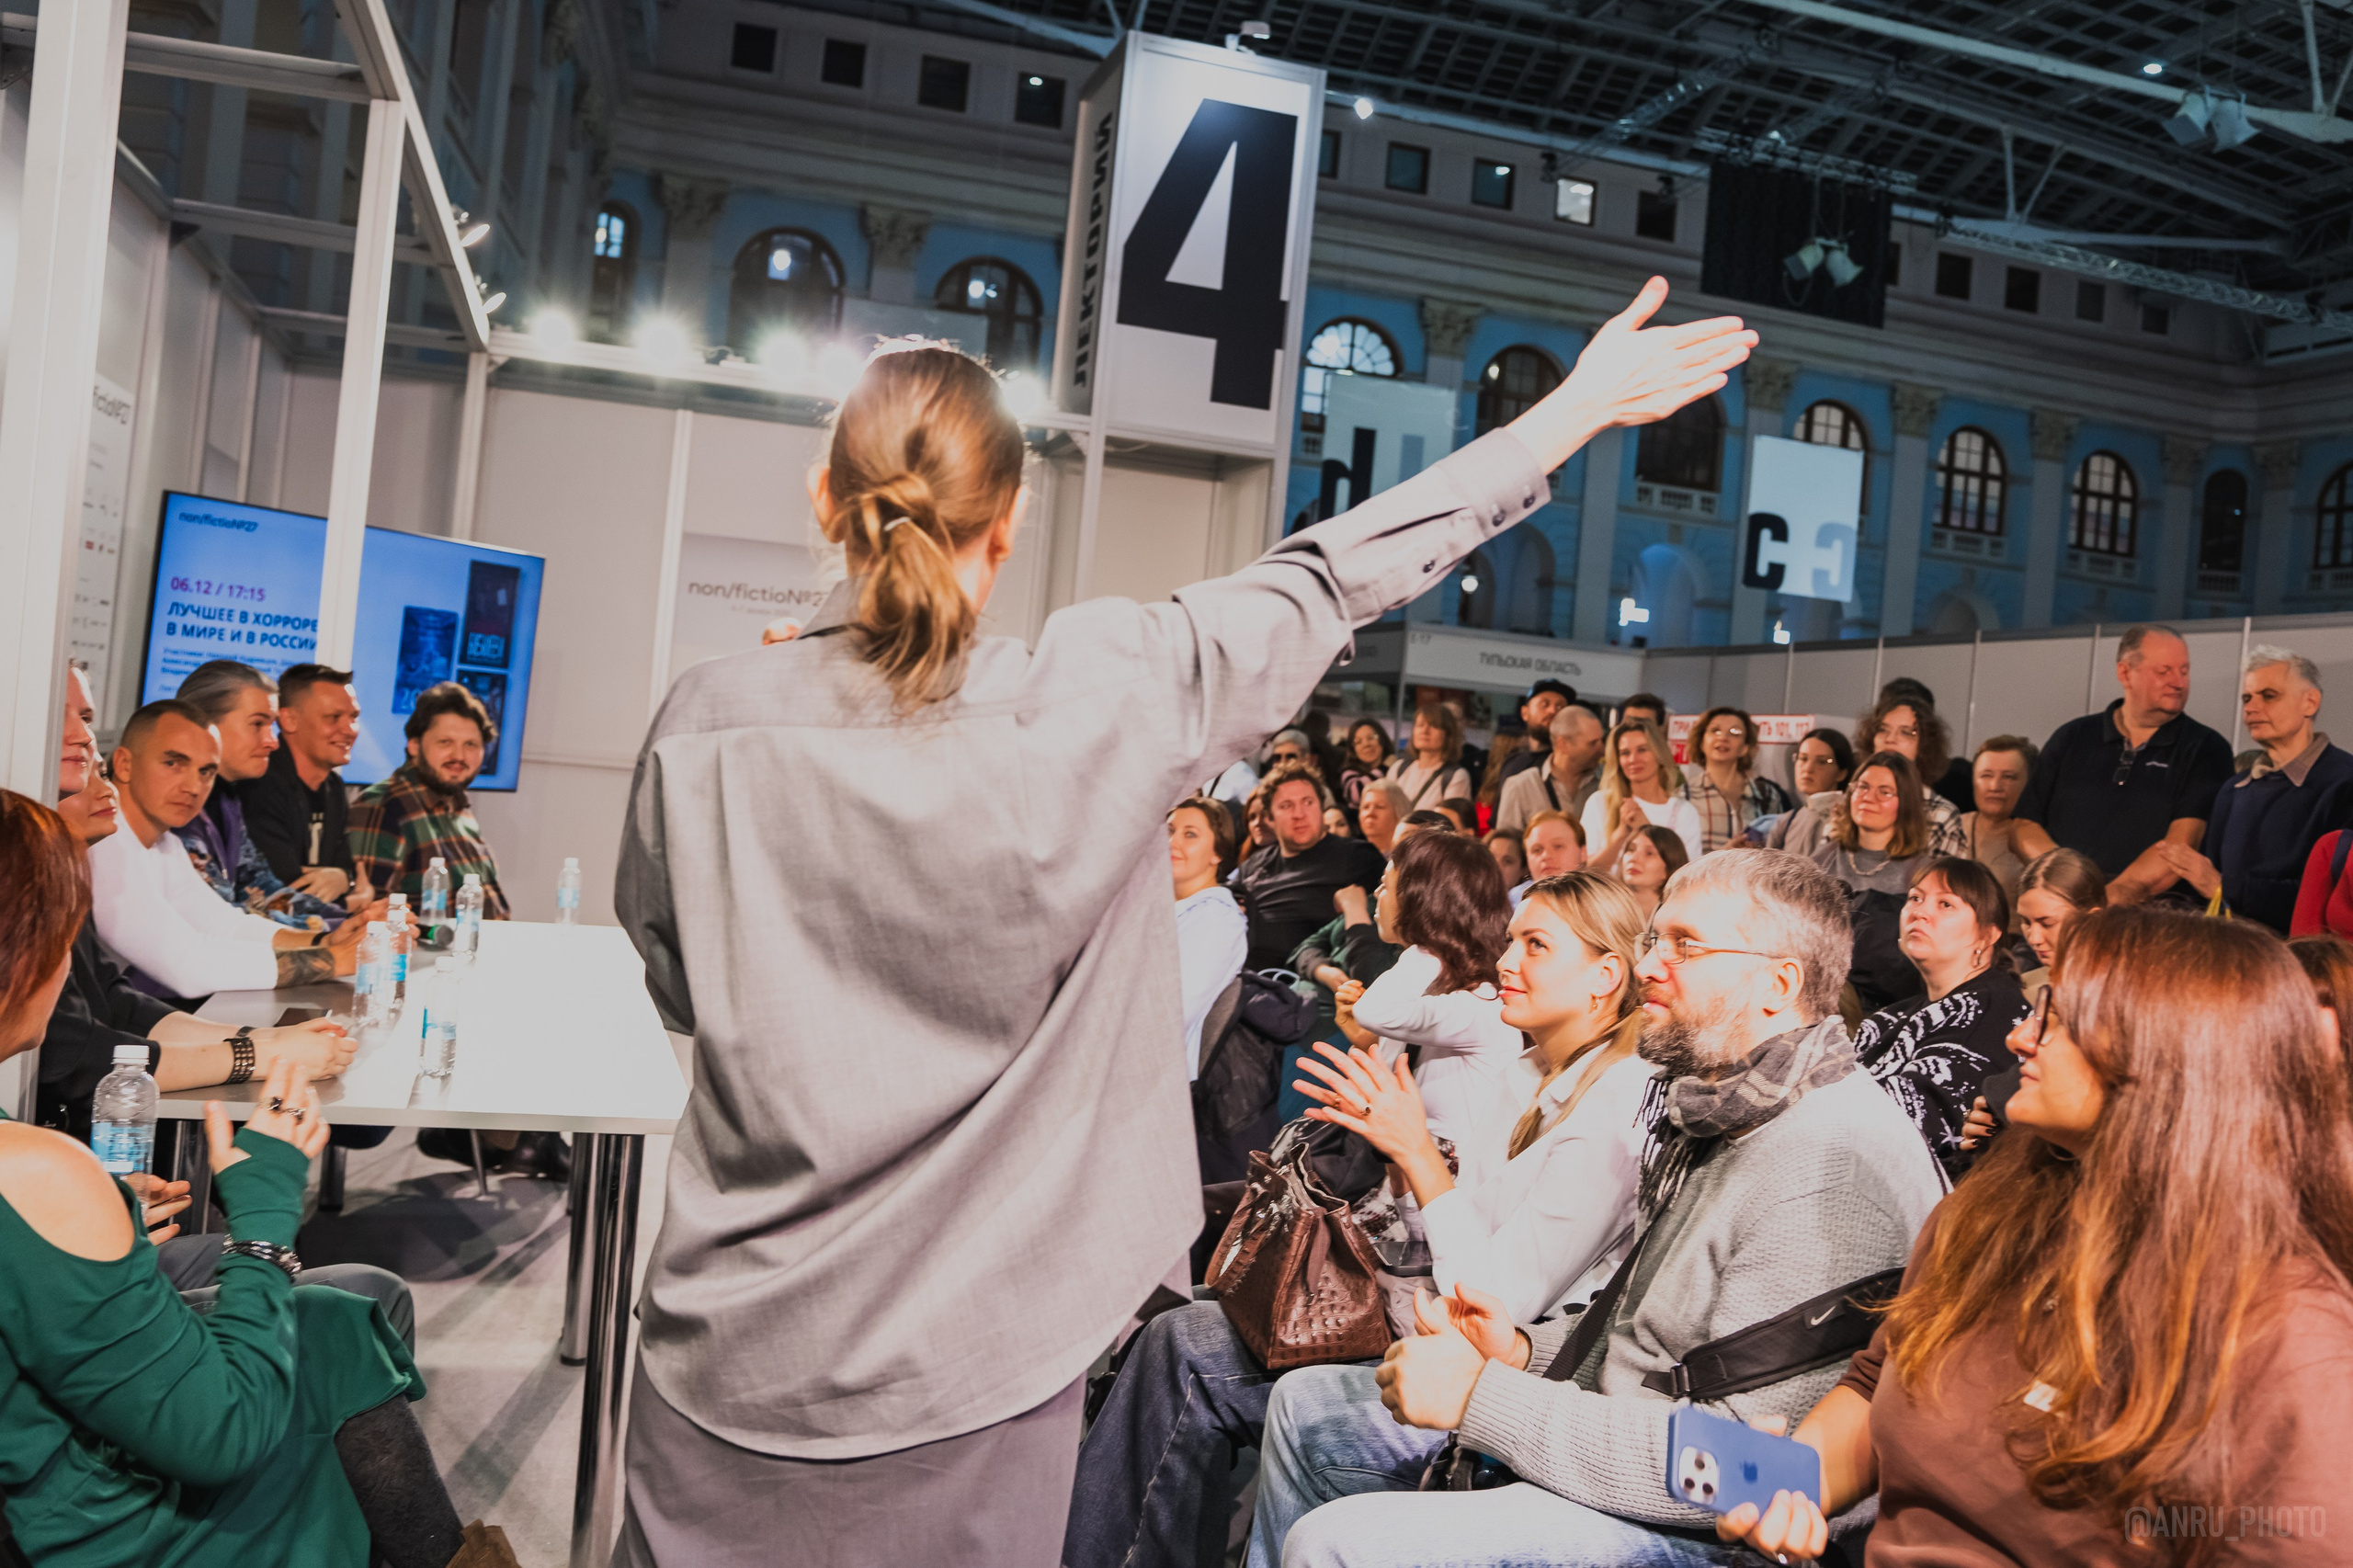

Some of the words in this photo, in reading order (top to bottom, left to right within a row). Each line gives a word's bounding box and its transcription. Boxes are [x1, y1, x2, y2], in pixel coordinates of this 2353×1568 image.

[1074, 112, 1113, 388] ЛЕКТОРИЙ
[1116, 97, 1298, 411] 4
[171, 576, 212, 595] 06.12
[228, 585, 267, 602] 17:15
[167, 601, 234, 622] ЛУЧШЕЕ
[239, 610, 248, 624] В
[253, 612, 318, 632] ХОРРОРЕ
[166, 621, 176, 636] В
[181, 623, 225, 642] МИРЕ
[231, 631, 242, 642] И
[245, 631, 256, 644] В
[1535, 657, 1581, 676] ОБЛАСТЬ
